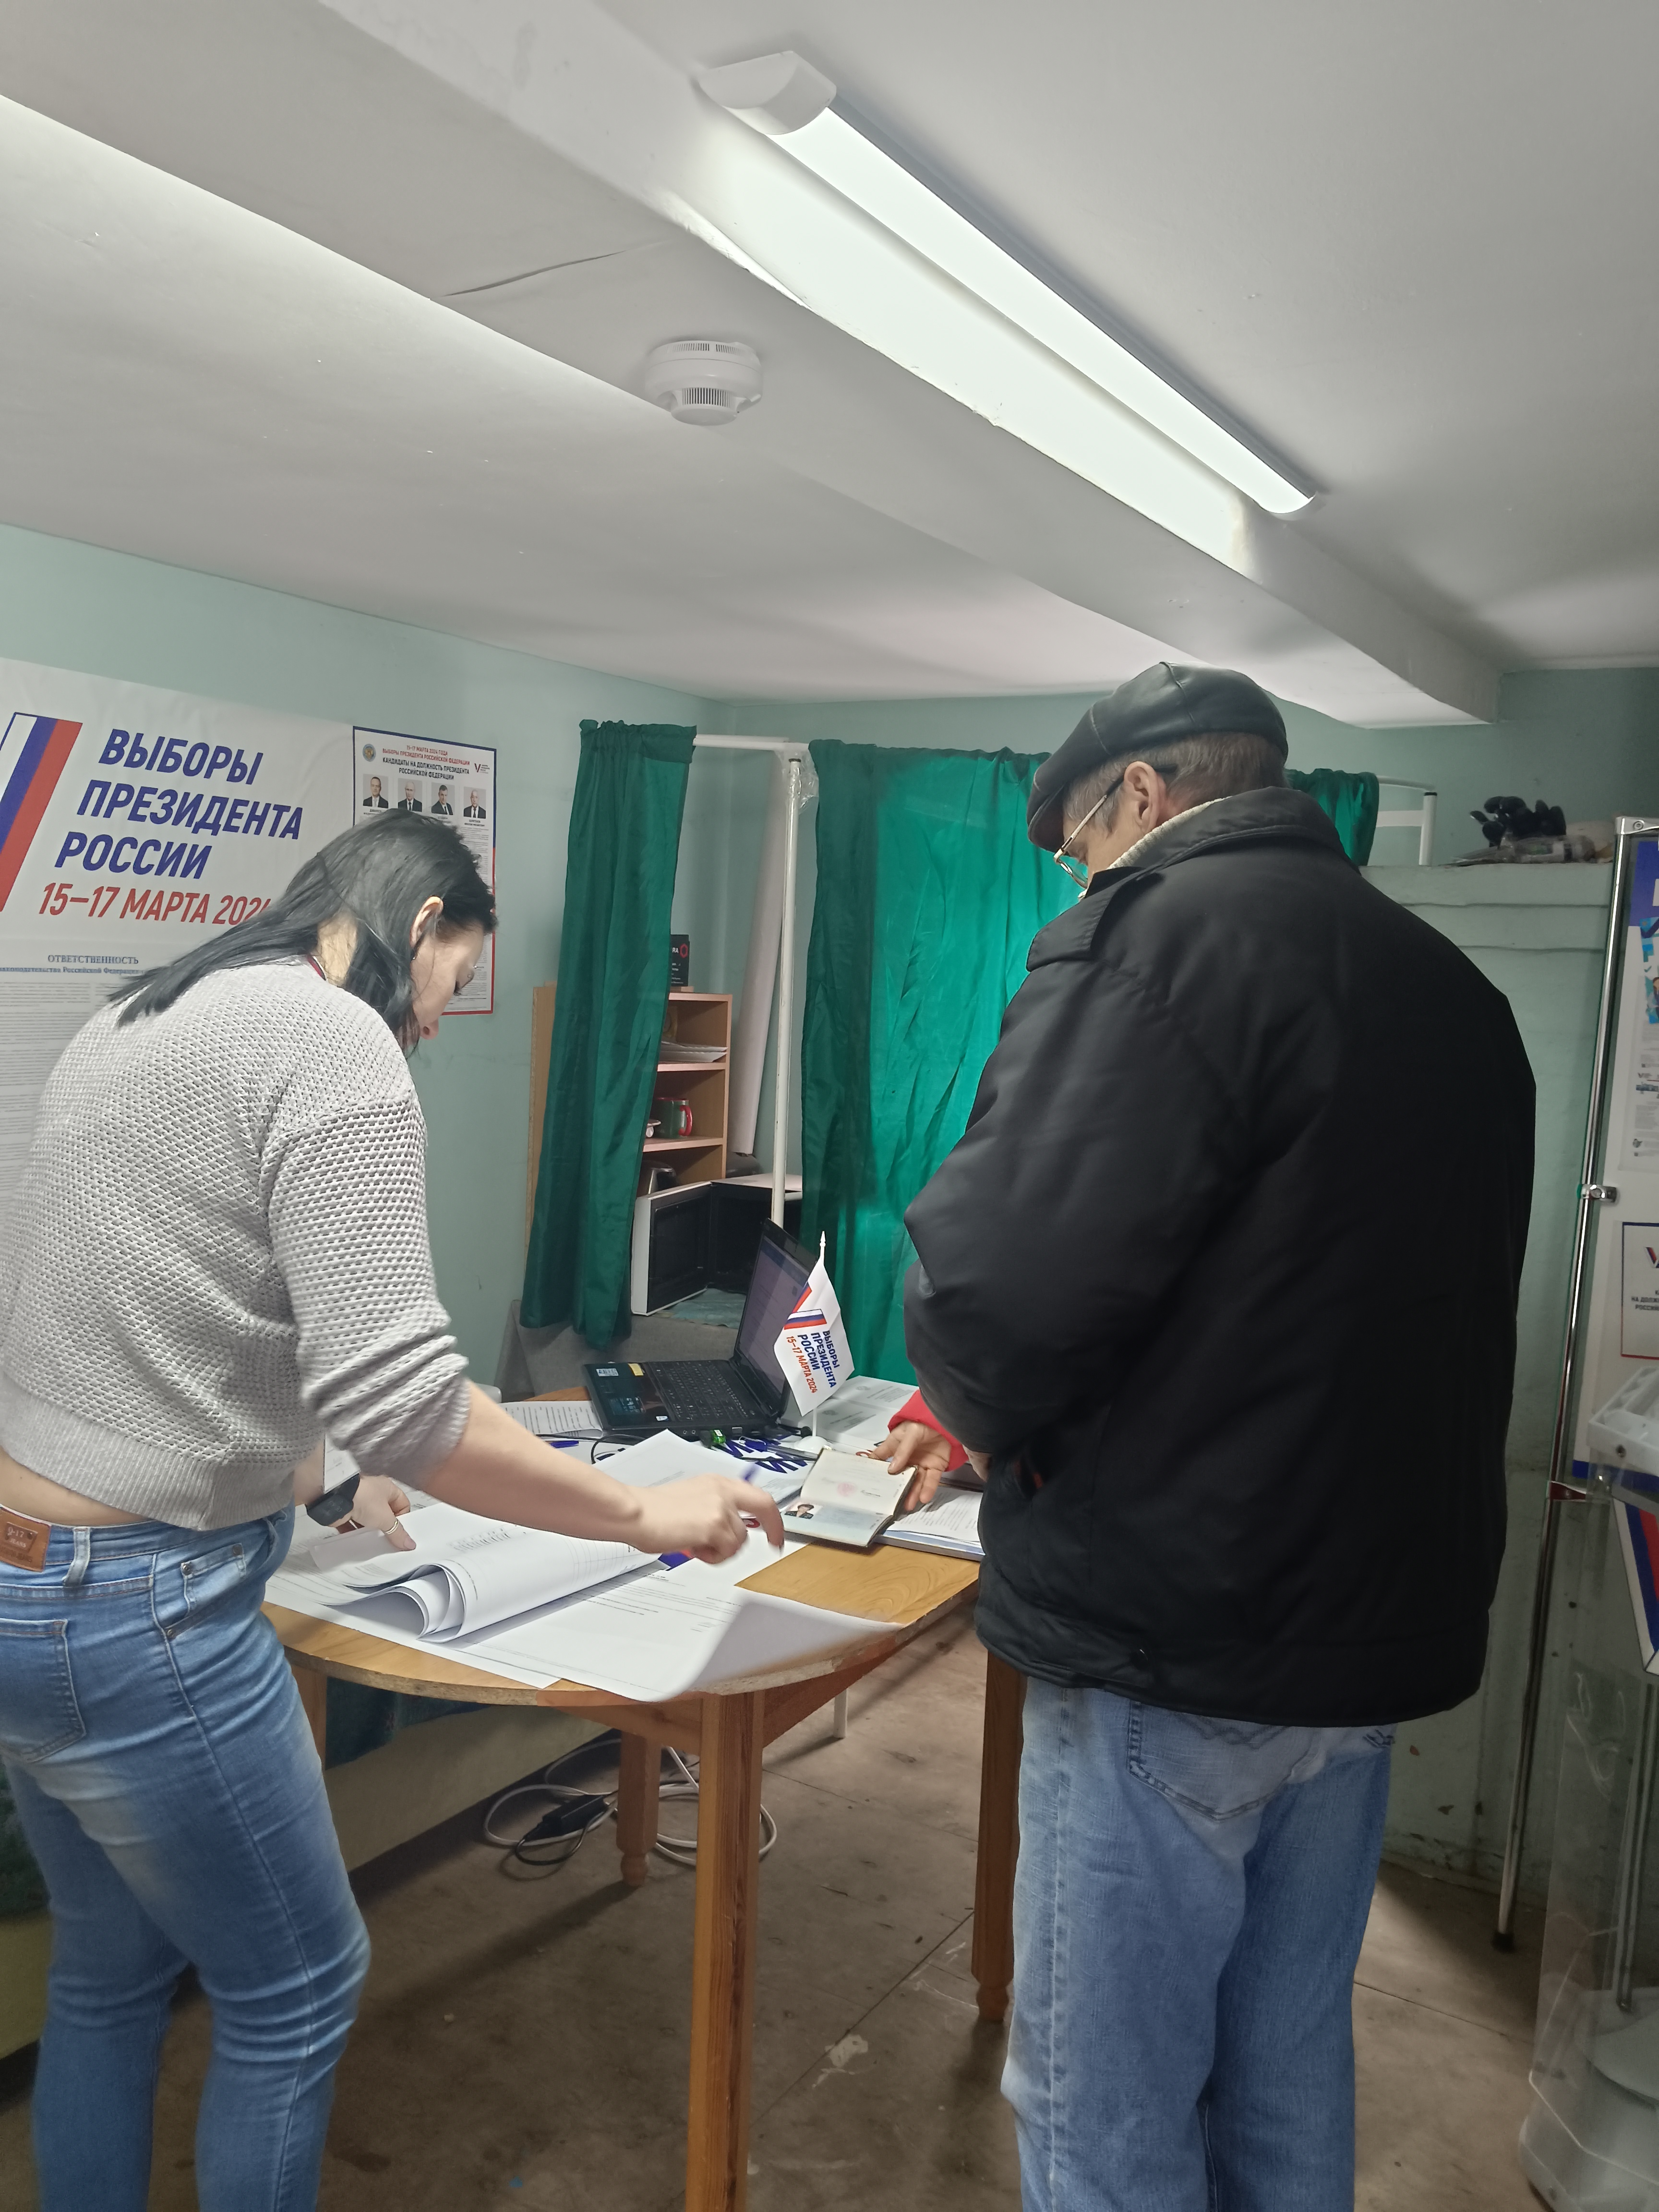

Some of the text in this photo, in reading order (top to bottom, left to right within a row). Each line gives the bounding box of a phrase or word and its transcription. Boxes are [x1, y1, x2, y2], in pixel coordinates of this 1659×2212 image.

[98, 728, 264, 785] ВЫБОРЫ
[383, 757, 409, 766] КАНДИДАТЫ
[417, 762, 443, 771] ДОЛЖНОСТЬ
[444, 766, 469, 774] ПРЕЗИДЕНТА
[399, 768, 454, 780] РОССИЙСКОЙ ФЕДЕРАЦИИ
[424, 754, 448, 762] РОССИЙСКОЙ
[449, 757, 470, 766] ФЕДЕРАЦИИ
[77, 779, 303, 840] ПРЕЗИДЕНТА
[54, 831, 212, 879] РОССИИ
[120, 888, 210, 924] МАРТА
[48, 954, 139, 964] ОТВЕТСТВЕННОСТЬ
[797, 1334, 820, 1370] РОССИИ
[811, 1332, 837, 1388] ПРЕЗИДЕНТА
[822, 1330, 840, 1368] ВЫБОРЫ
[796, 1355, 812, 1377] МАРТА
[806, 1378, 817, 1393] 2024
